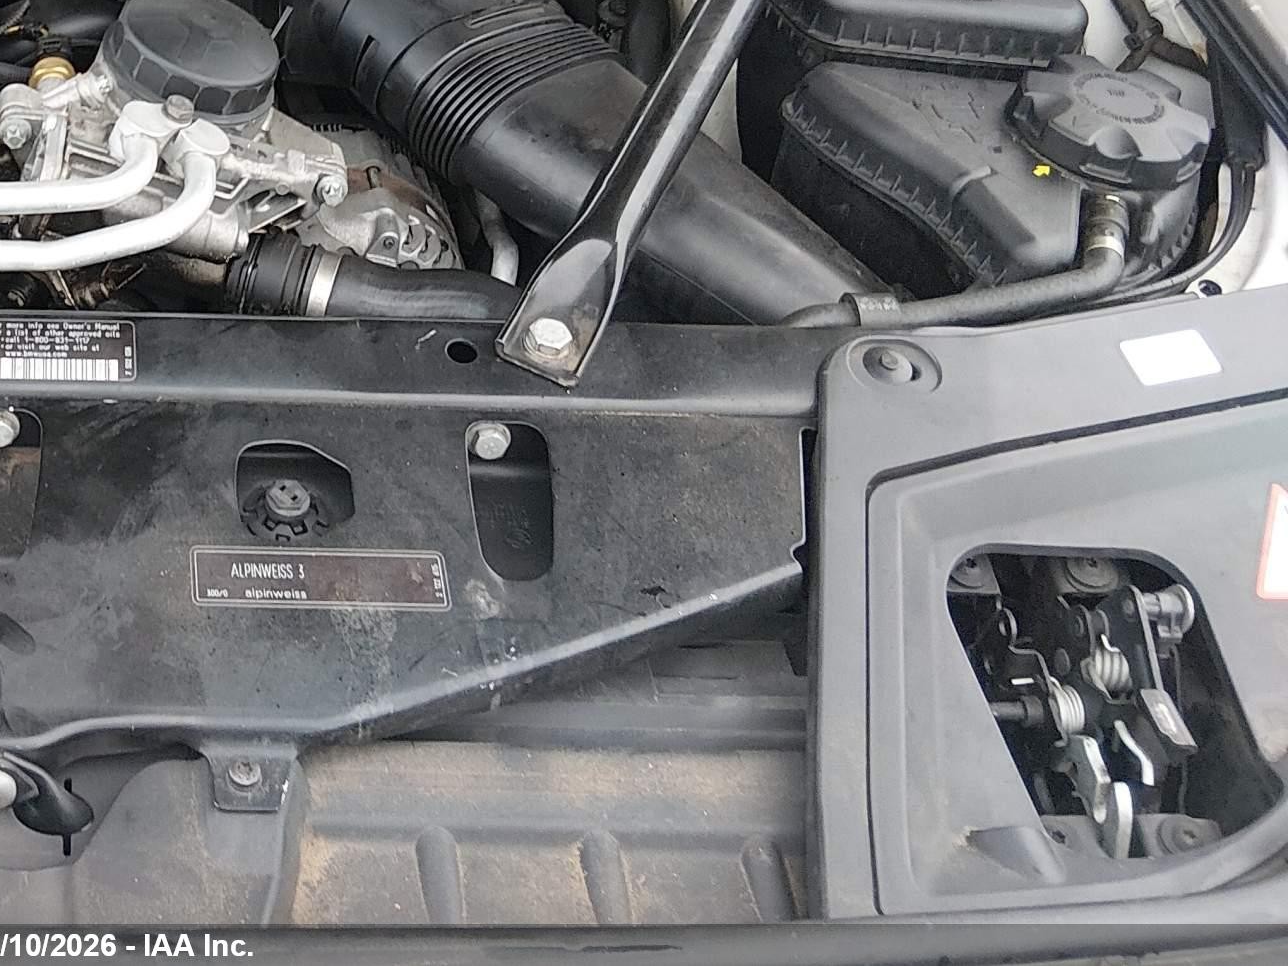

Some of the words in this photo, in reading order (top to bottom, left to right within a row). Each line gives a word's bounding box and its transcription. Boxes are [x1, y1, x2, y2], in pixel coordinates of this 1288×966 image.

[95, 323, 120, 331] Manual
[45, 329, 64, 337] other
[68, 330, 102, 338] approved
[230, 562, 294, 579] ALPINWEISS
[298, 563, 305, 579] 3
[244, 588, 308, 601] alpinweiss
